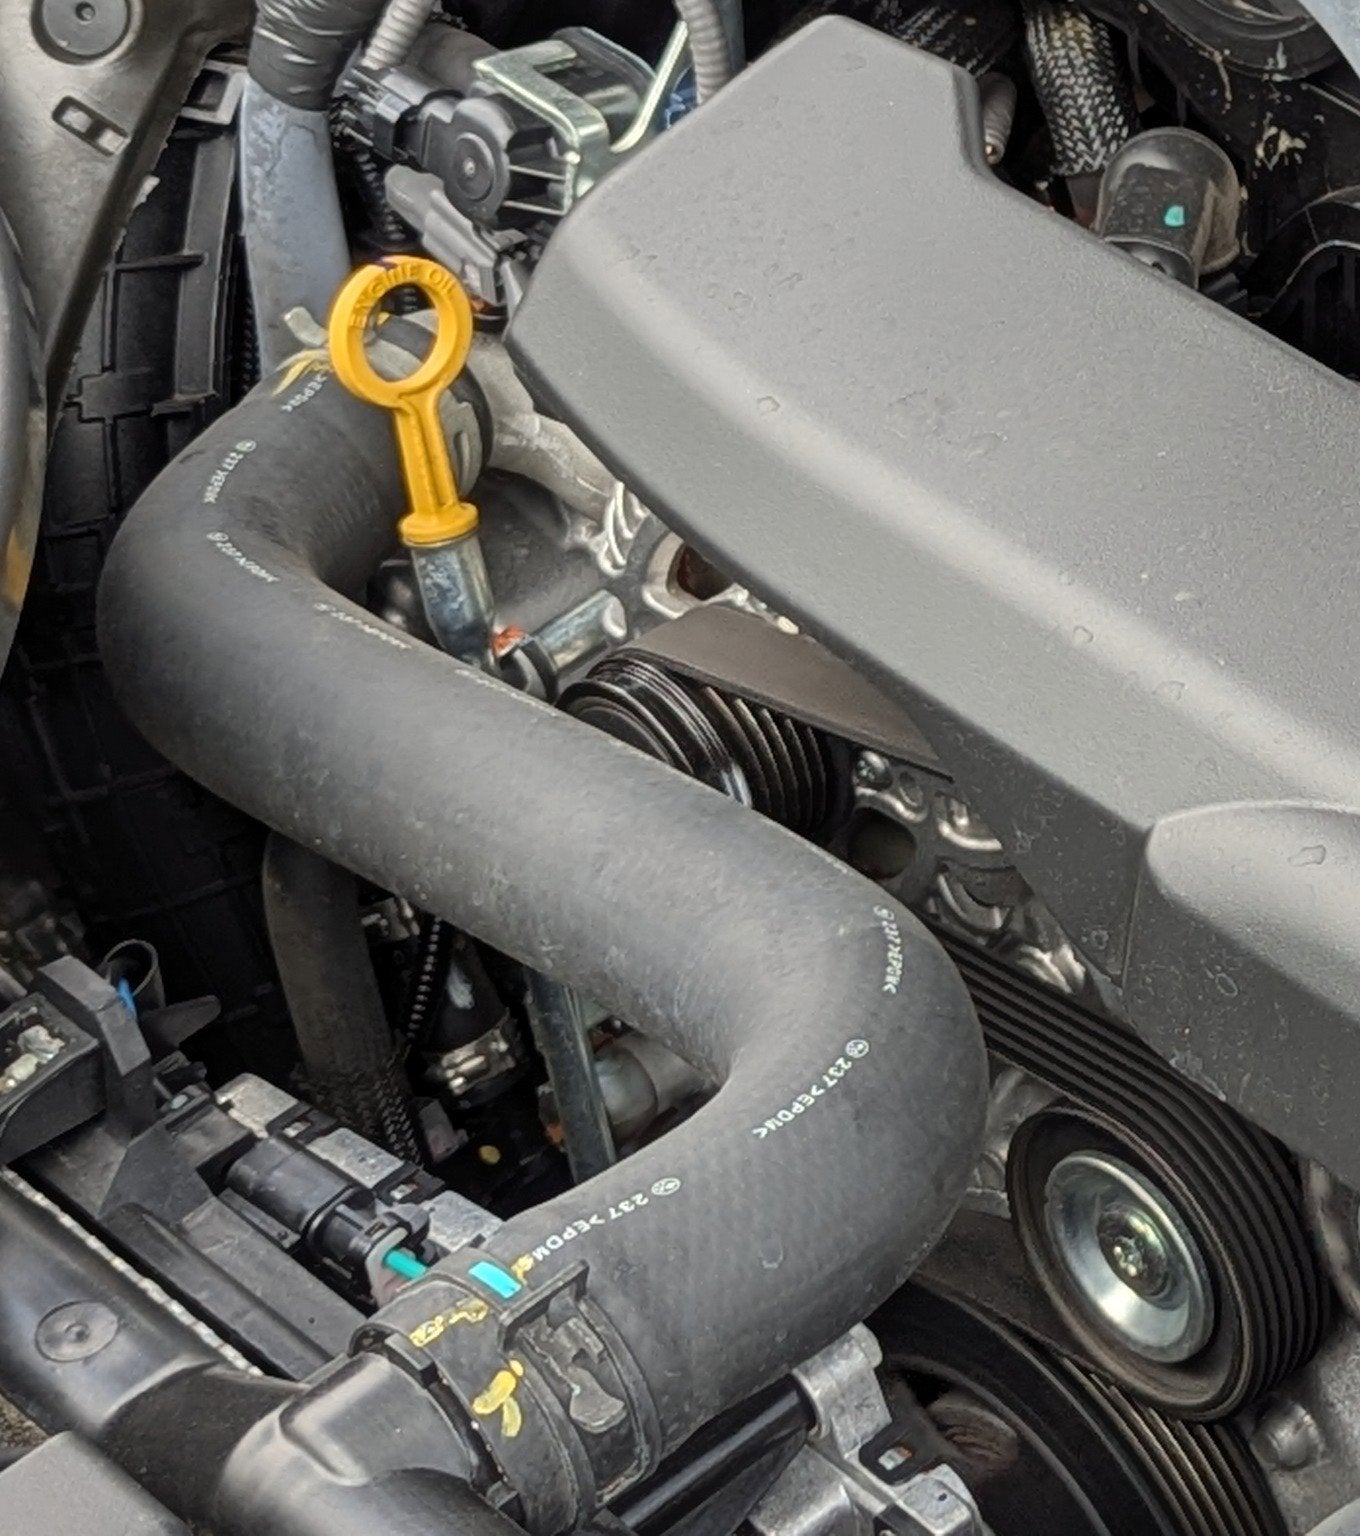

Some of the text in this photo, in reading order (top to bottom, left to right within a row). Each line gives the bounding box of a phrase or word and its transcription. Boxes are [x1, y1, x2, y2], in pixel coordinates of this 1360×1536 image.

[348, 262, 458, 329] ENGINE OIL
[822, 1057, 853, 1089] 237
[531, 1192, 650, 1262] 237 >EPDM
